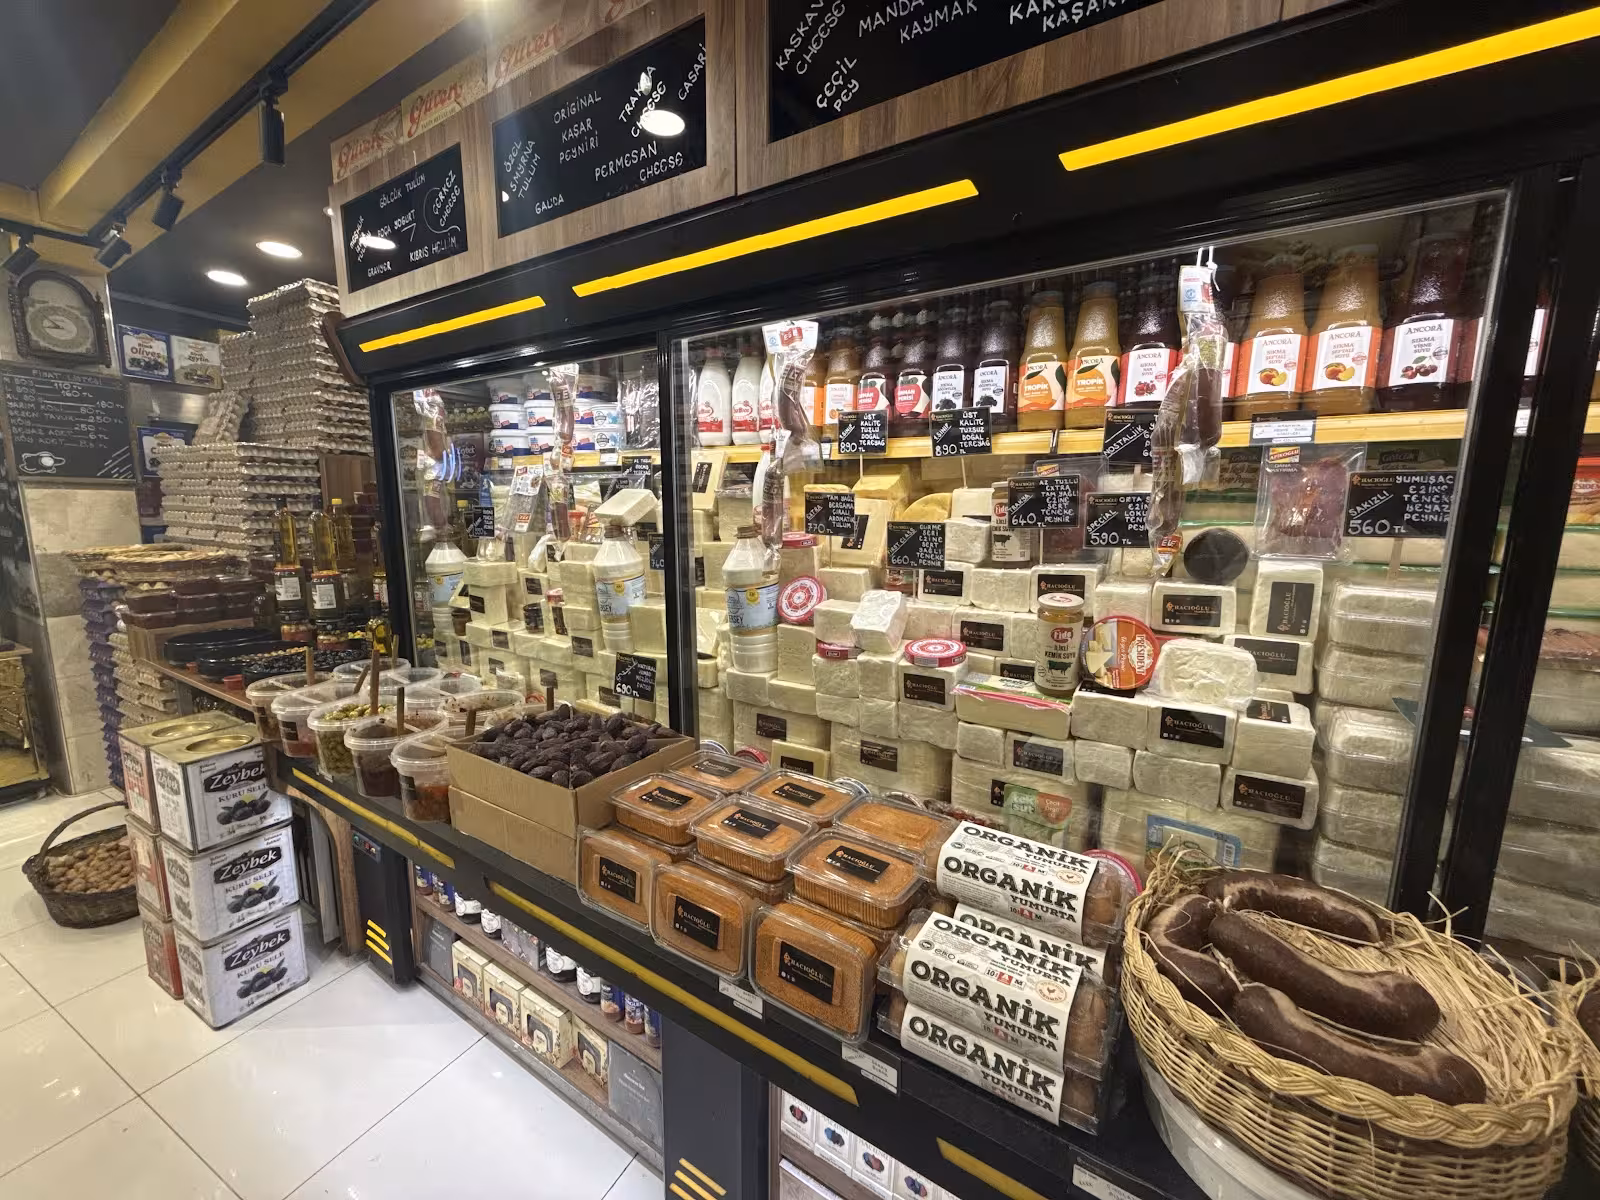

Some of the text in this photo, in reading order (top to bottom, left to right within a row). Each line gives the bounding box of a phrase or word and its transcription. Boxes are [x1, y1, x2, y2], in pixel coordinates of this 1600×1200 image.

[554, 91, 601, 124] ORİGİNAL
[833, 78, 860, 112] PEY
[562, 118, 593, 143] KAŞAR
[560, 131, 599, 163] PEYNİRİ
[595, 141, 657, 181] PERMESAN
[640, 152, 683, 182] CHEESE
[518, 154, 541, 199] TULUM
[1329, 331, 1362, 340] ANCORA
[1406, 324, 1443, 334] ANCORA
[1263, 338, 1293, 346] ANCORA
[1077, 377, 1104, 385] TROPİK
[840, 442, 857, 453] 890
[935, 444, 957, 456] 890
[1349, 490, 1389, 517] SAKIZLI
[808, 523, 825, 533] 770
[1012, 513, 1036, 526] 640
[1348, 519, 1390, 535] 560
[1090, 532, 1119, 545] 590
[891, 555, 909, 565] 660
[1136, 635, 1146, 675] PRÉSIDENT
[616, 683, 632, 694] 690
[1173, 719, 1213, 730] HACIOĞLU
[219, 791, 245, 802] KURU
[1248, 788, 1290, 800] HACIOĞLU
[963, 826, 1090, 869] ORGANİK
[220, 850, 277, 880] Zeybek
[844, 853, 874, 869] HACIOĞLU
[1024, 853, 1088, 874] YUMURTA
[226, 870, 274, 893] KURU SELE
[944, 856, 1078, 913] ORGANİK
[683, 910, 711, 929] HACIOĞLU
[1010, 894, 1077, 923] YUMURTA
[231, 933, 286, 967] Zeybek
[933, 918, 1075, 981] ORGANİK
[237, 950, 285, 978] KURU SELE
[790, 957, 824, 980] HACIOĞLU
[1001, 955, 1071, 987] YUMURTA
[911, 959, 1060, 1040] ORGANİK
[983, 1011, 1058, 1052] YUMURTA
[908, 1015, 1057, 1101] ORGANİK
[980, 1070, 1055, 1113] YUMURTA
